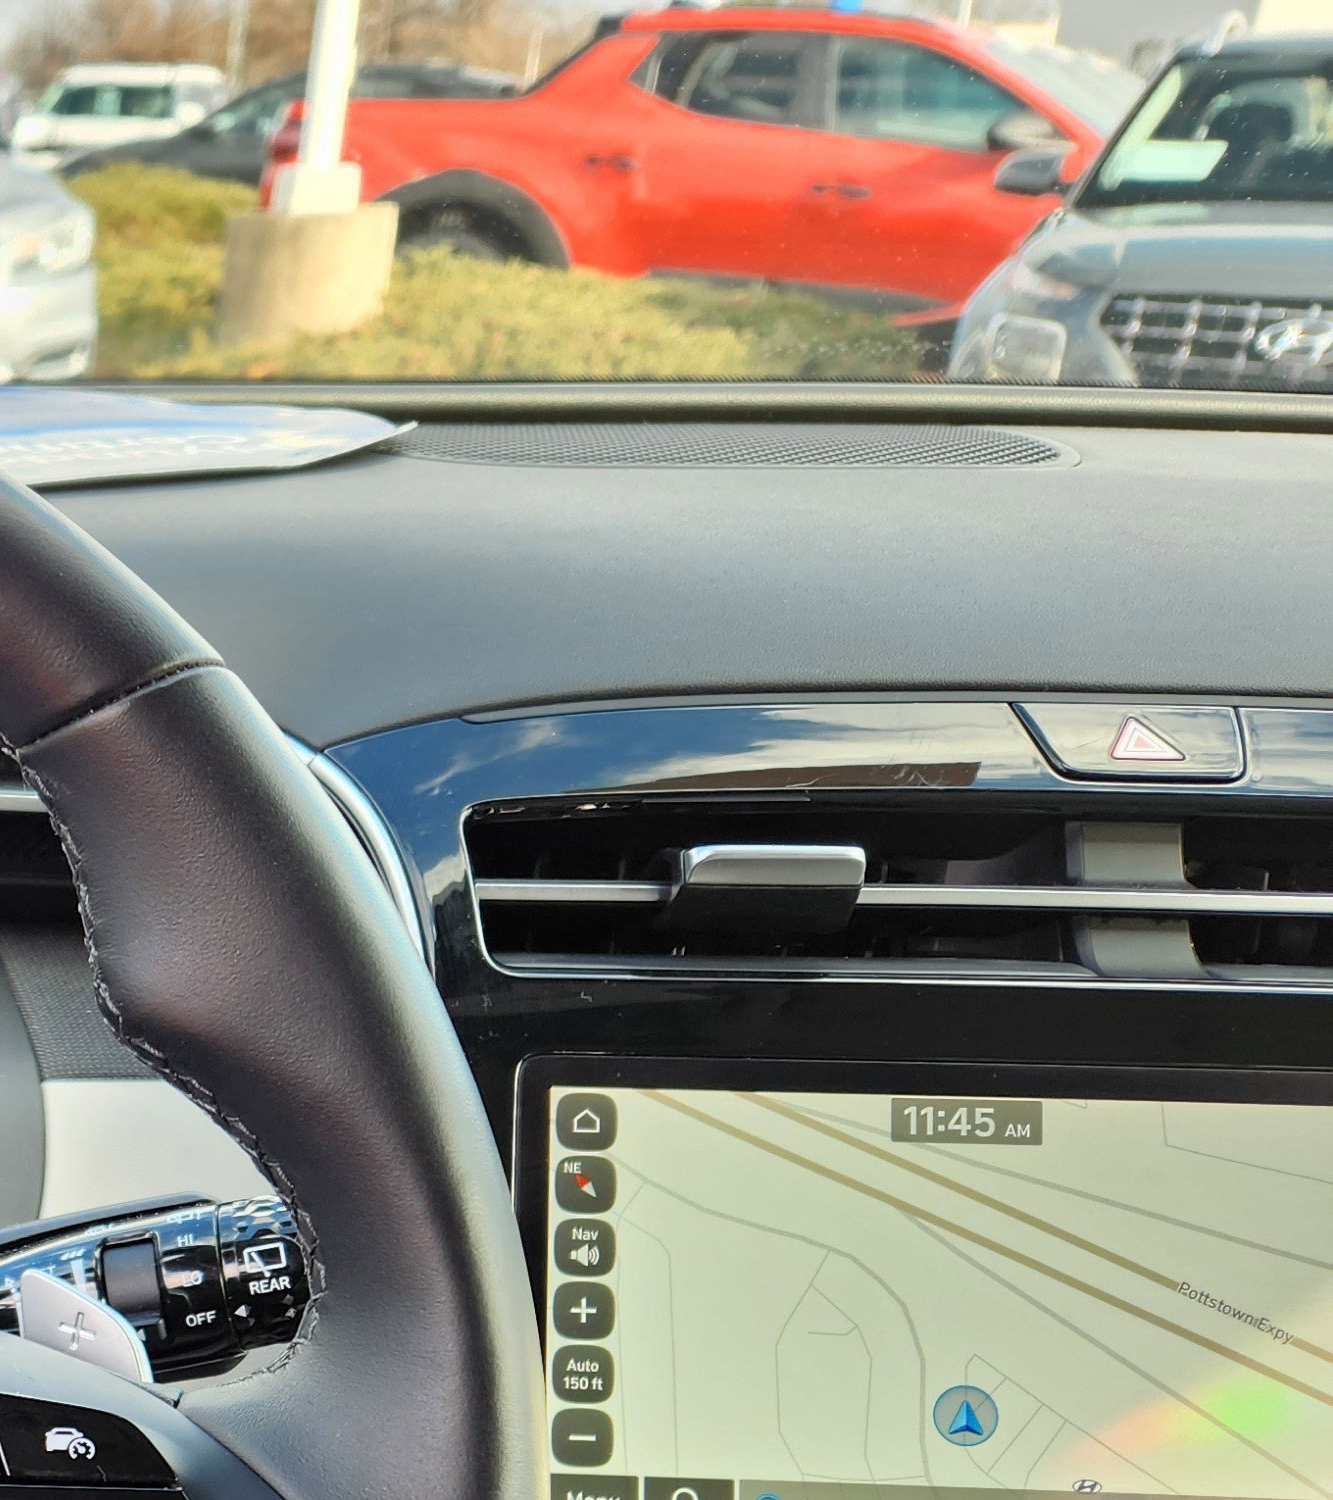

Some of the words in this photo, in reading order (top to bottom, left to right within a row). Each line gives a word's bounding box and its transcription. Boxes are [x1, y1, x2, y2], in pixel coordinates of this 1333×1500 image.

[902, 1107, 997, 1138] 11:45
[1005, 1123, 1031, 1138] AM
[564, 1161, 582, 1174] NE
[572, 1227, 598, 1241] Nav
[249, 1275, 292, 1295] REAR
[185, 1311, 217, 1328] OFF
[1178, 1281, 1255, 1326] Pottstown
[1256, 1317, 1295, 1345] Expy
[566, 1360, 599, 1373] Auto
[563, 1377, 585, 1391] 150
[588, 1377, 603, 1391] ft
